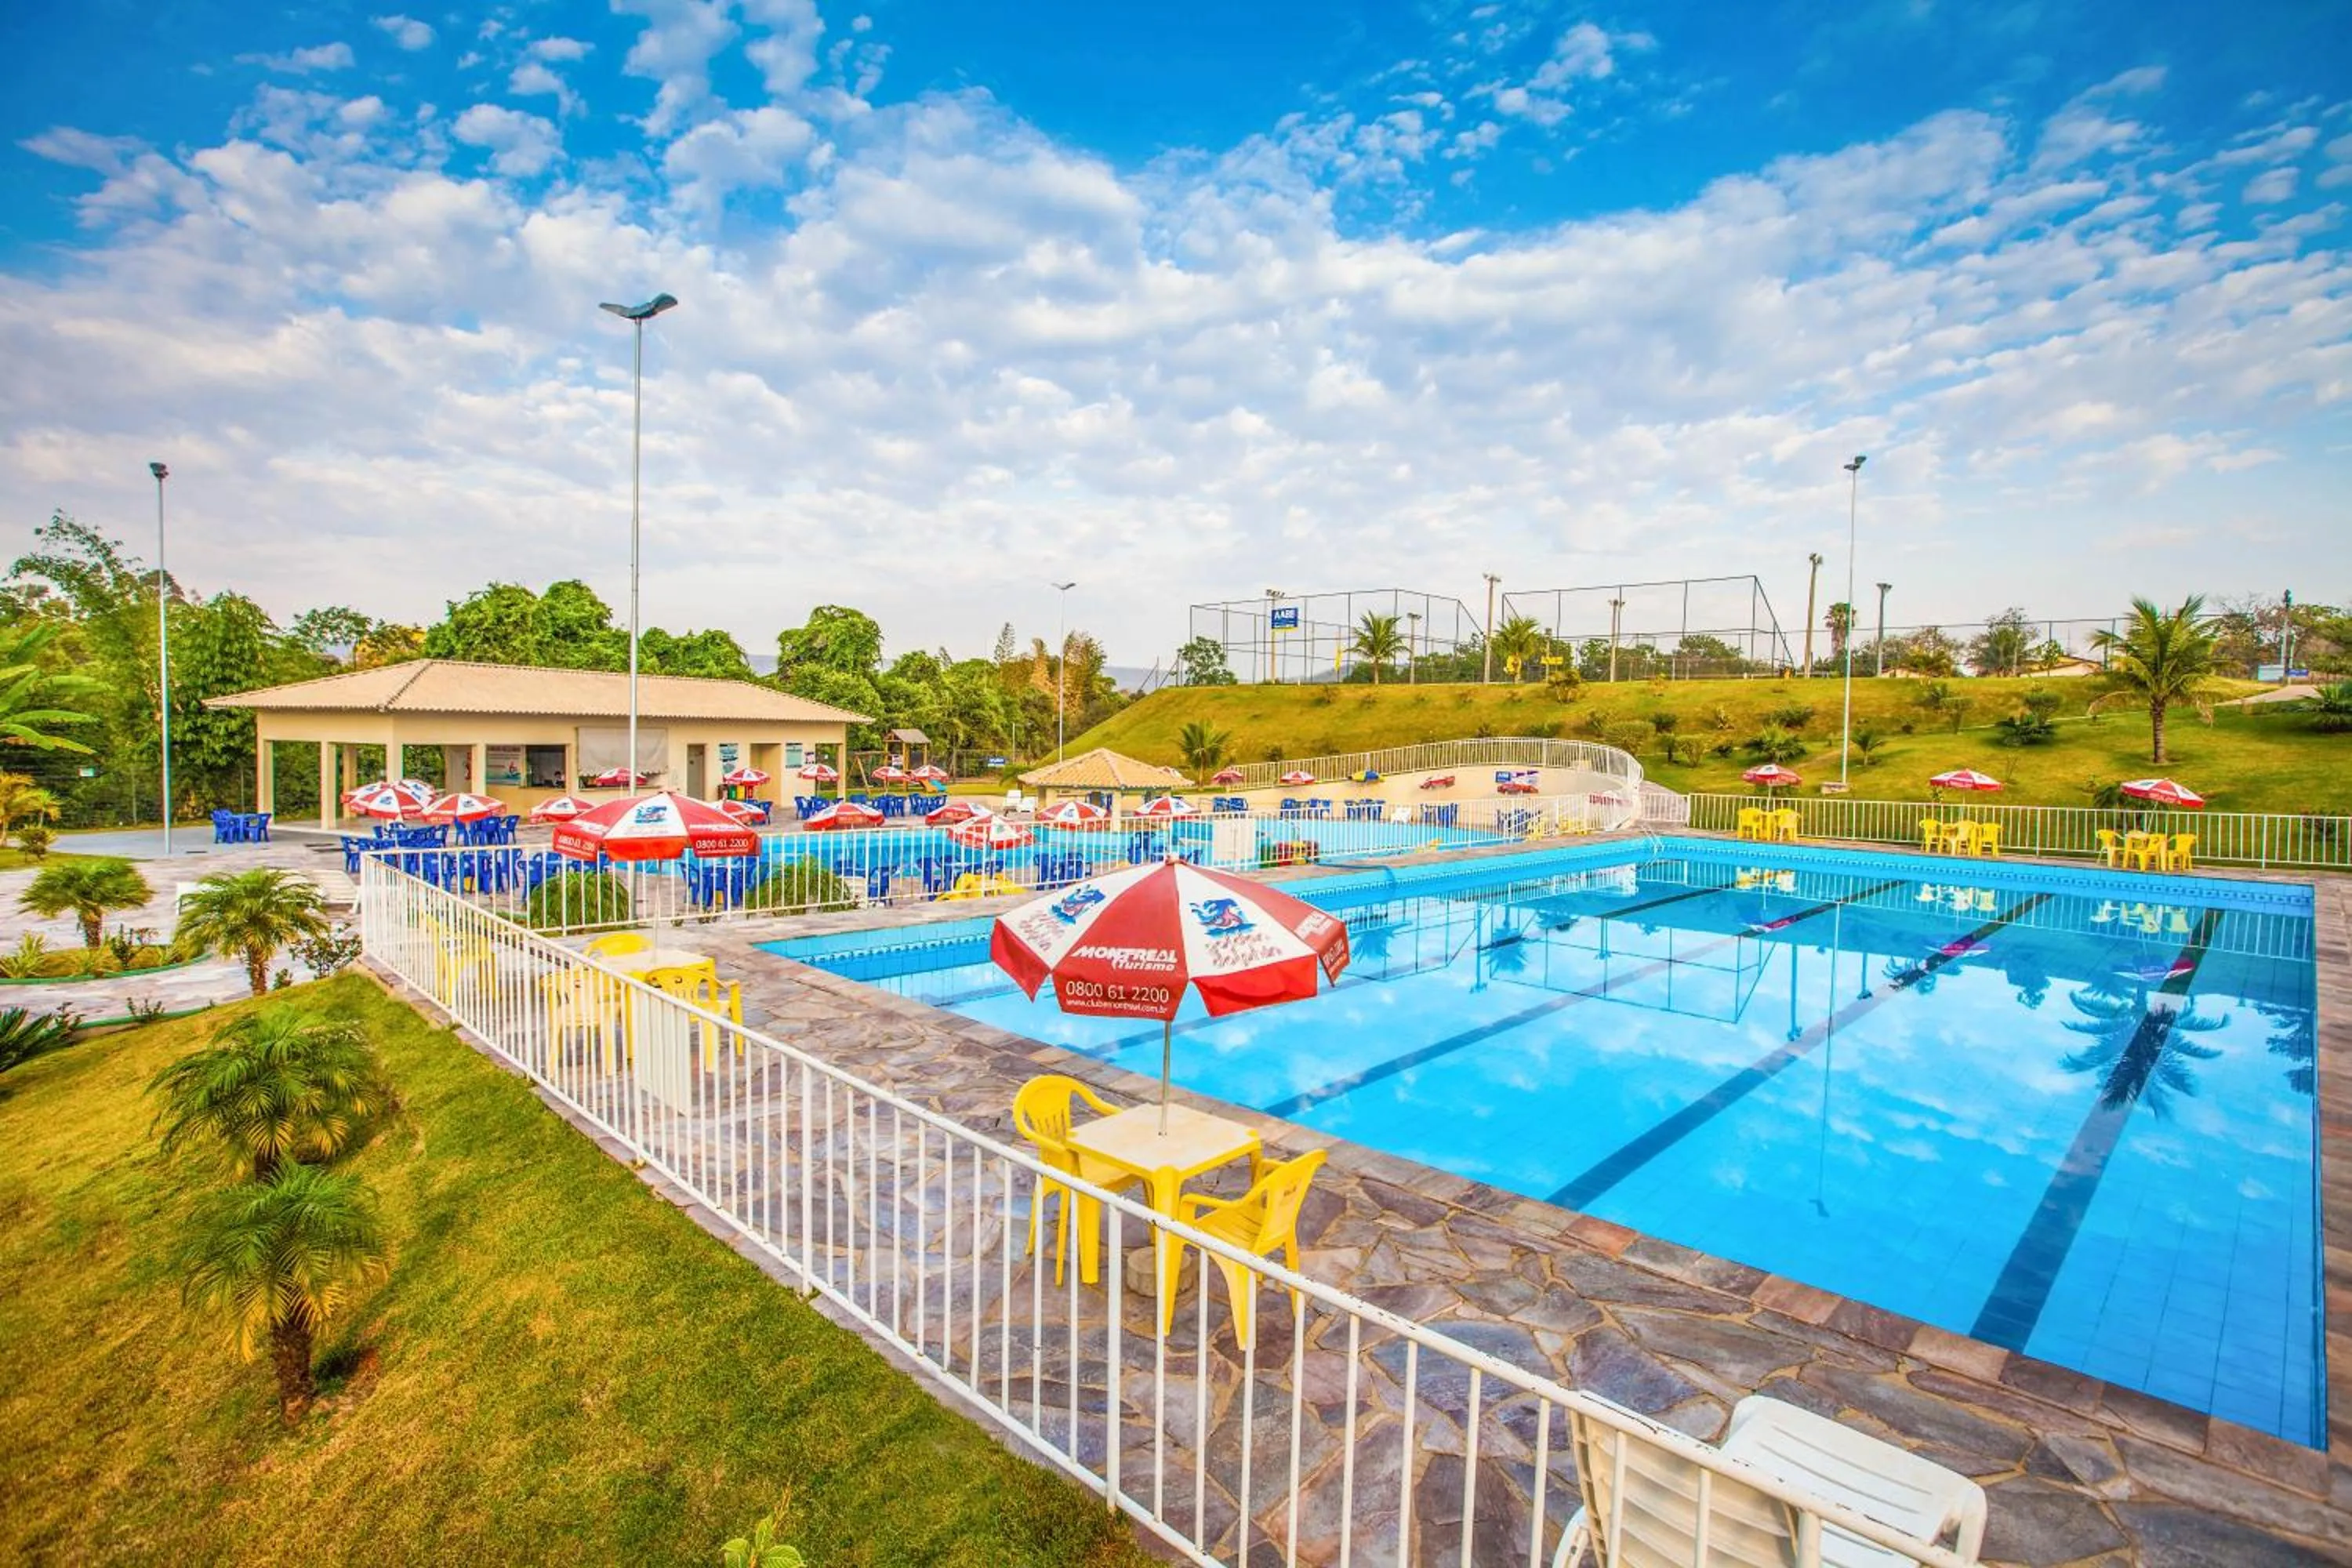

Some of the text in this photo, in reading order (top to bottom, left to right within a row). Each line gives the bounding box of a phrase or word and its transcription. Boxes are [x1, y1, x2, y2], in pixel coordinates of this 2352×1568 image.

[1071, 946, 1178, 964] MONTREAL
[1114, 960, 1174, 971] Turismo
[1065, 981, 1170, 1004] 0800 61 2200
